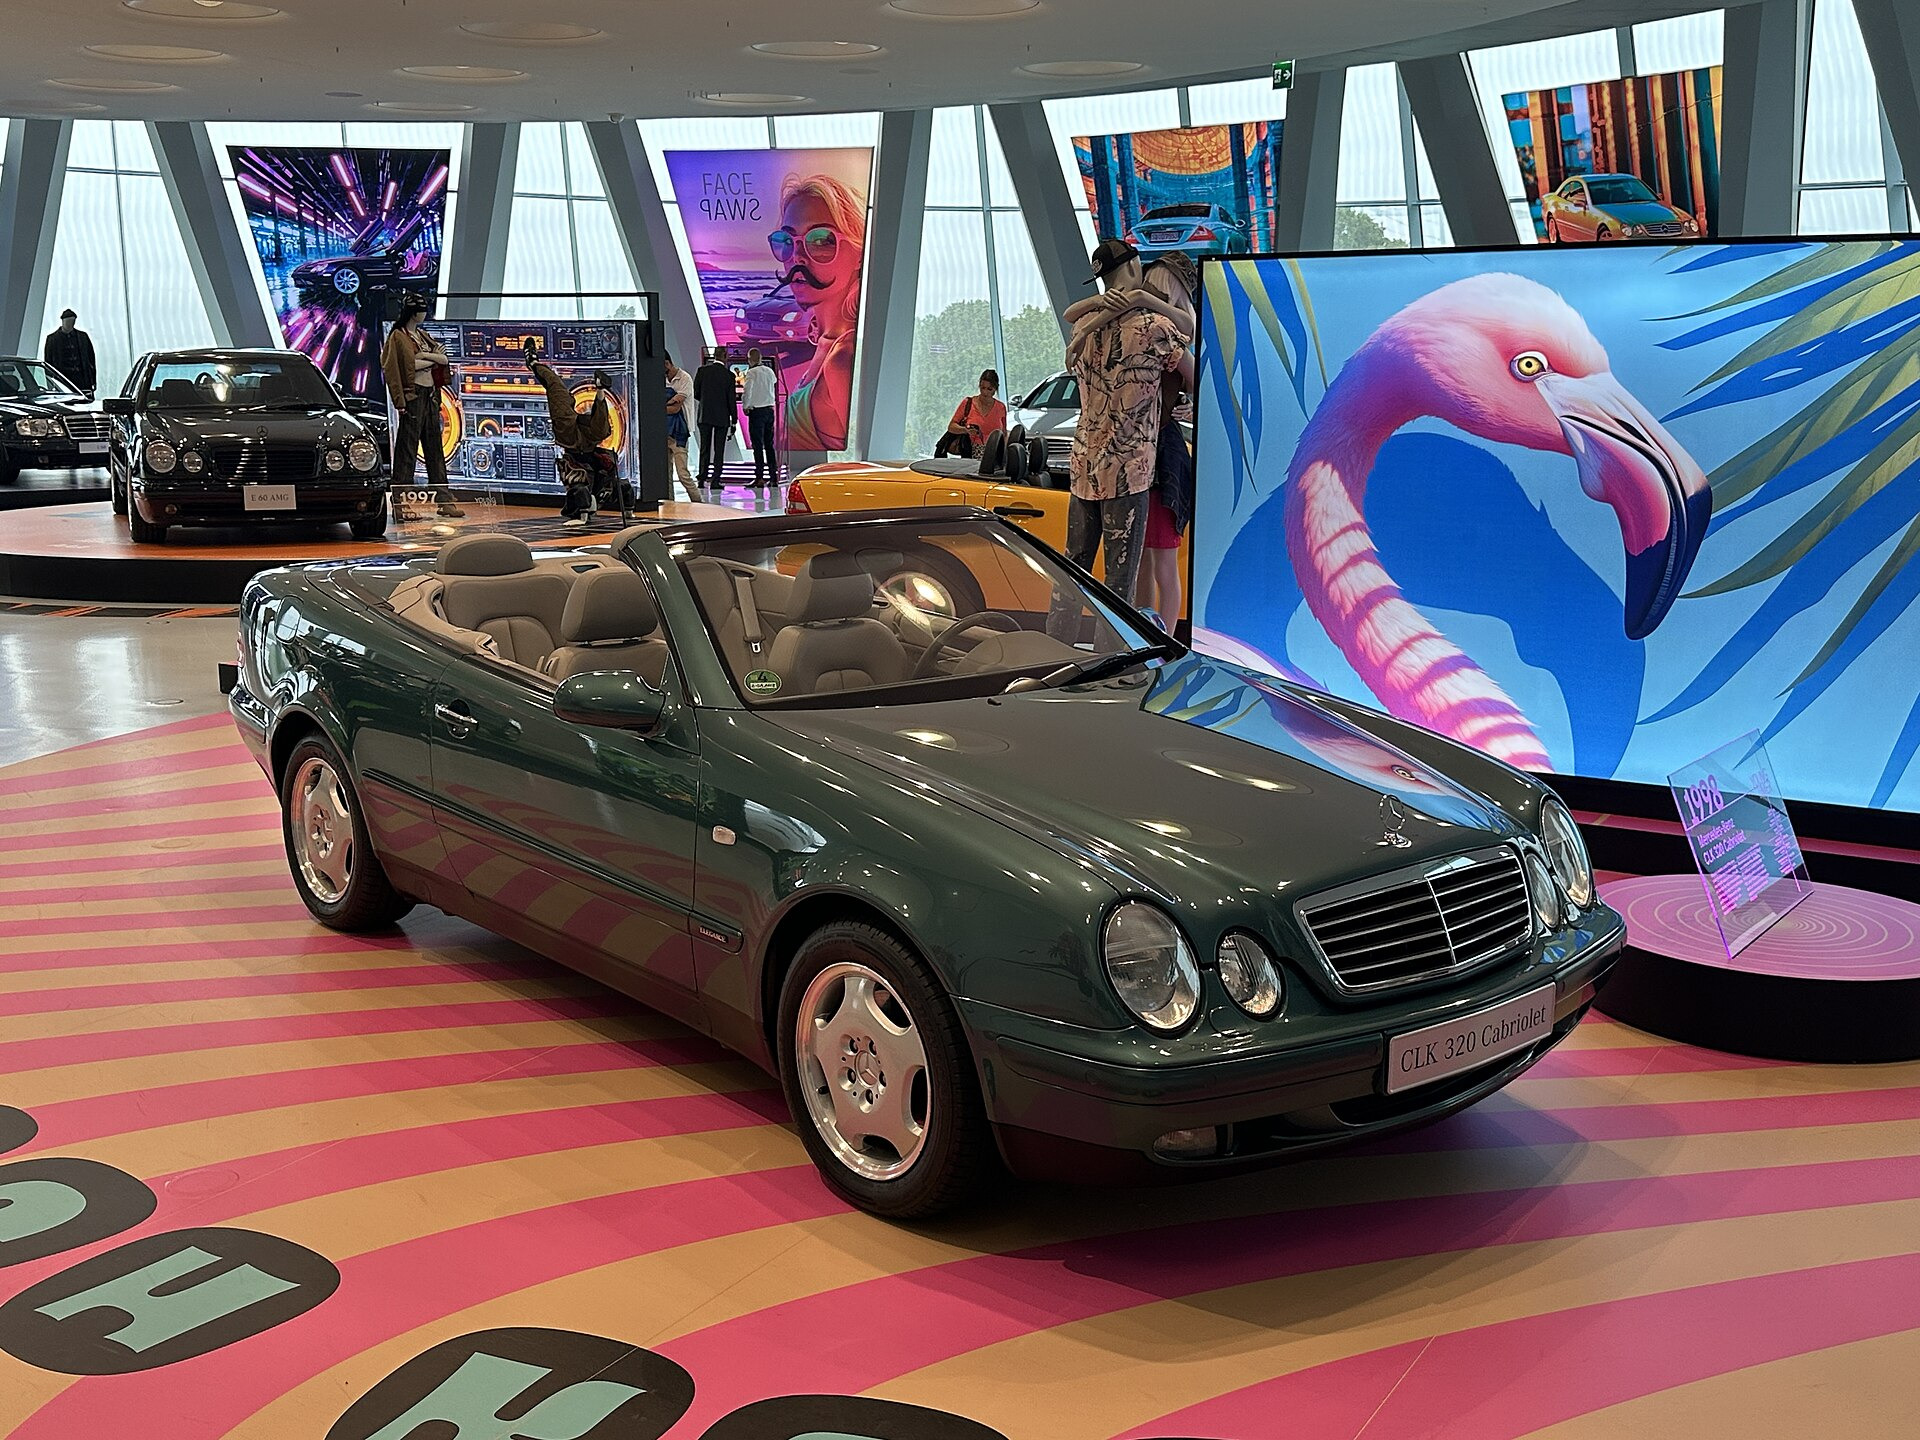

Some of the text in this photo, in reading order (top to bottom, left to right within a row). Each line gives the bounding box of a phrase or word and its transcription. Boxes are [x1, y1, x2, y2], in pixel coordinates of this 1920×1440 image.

[702, 172, 754, 196] FACE
[258, 494, 268, 502] 60
[270, 493, 289, 502] AMG
[400, 491, 437, 505] 1997
[1684, 774, 1724, 825] 1998
[1703, 848, 1716, 865] CLK
[1401, 1003, 1547, 1073] CLK 320 Cabriolet
